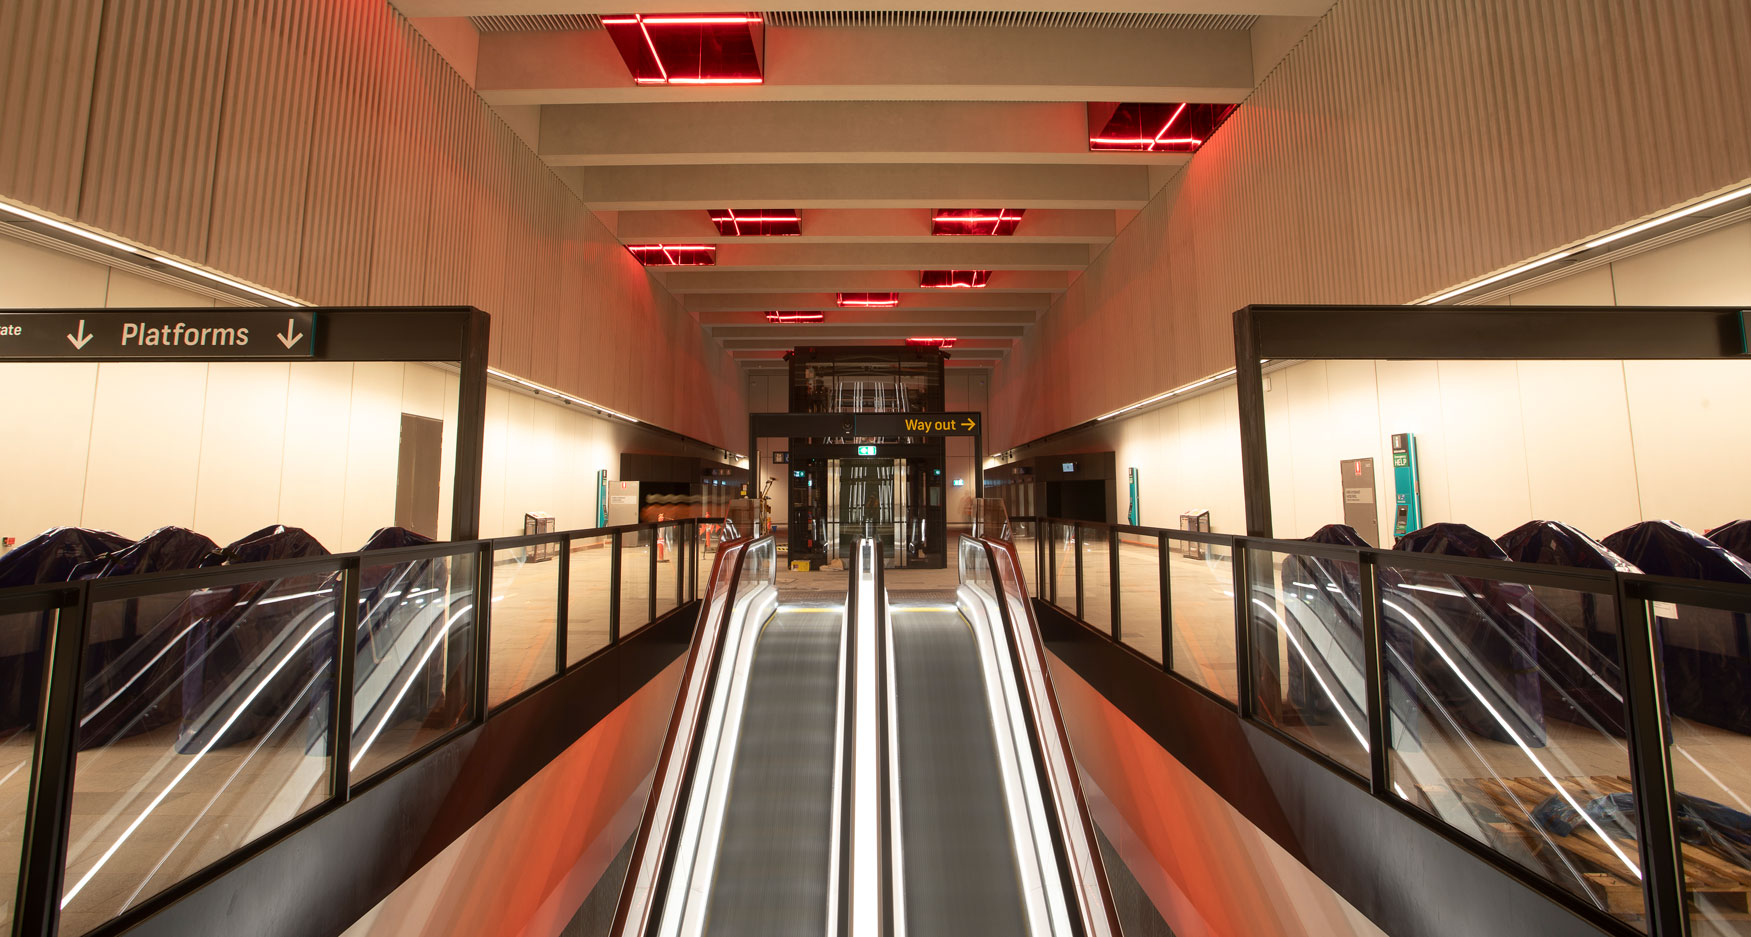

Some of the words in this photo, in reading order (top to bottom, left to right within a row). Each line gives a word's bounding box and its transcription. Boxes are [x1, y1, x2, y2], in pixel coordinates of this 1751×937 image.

[0, 324, 22, 336] ate
[121, 322, 249, 346] Platforms
[905, 419, 932, 433] Way
[934, 420, 956, 431] out
[1394, 458, 1407, 466] HELP
